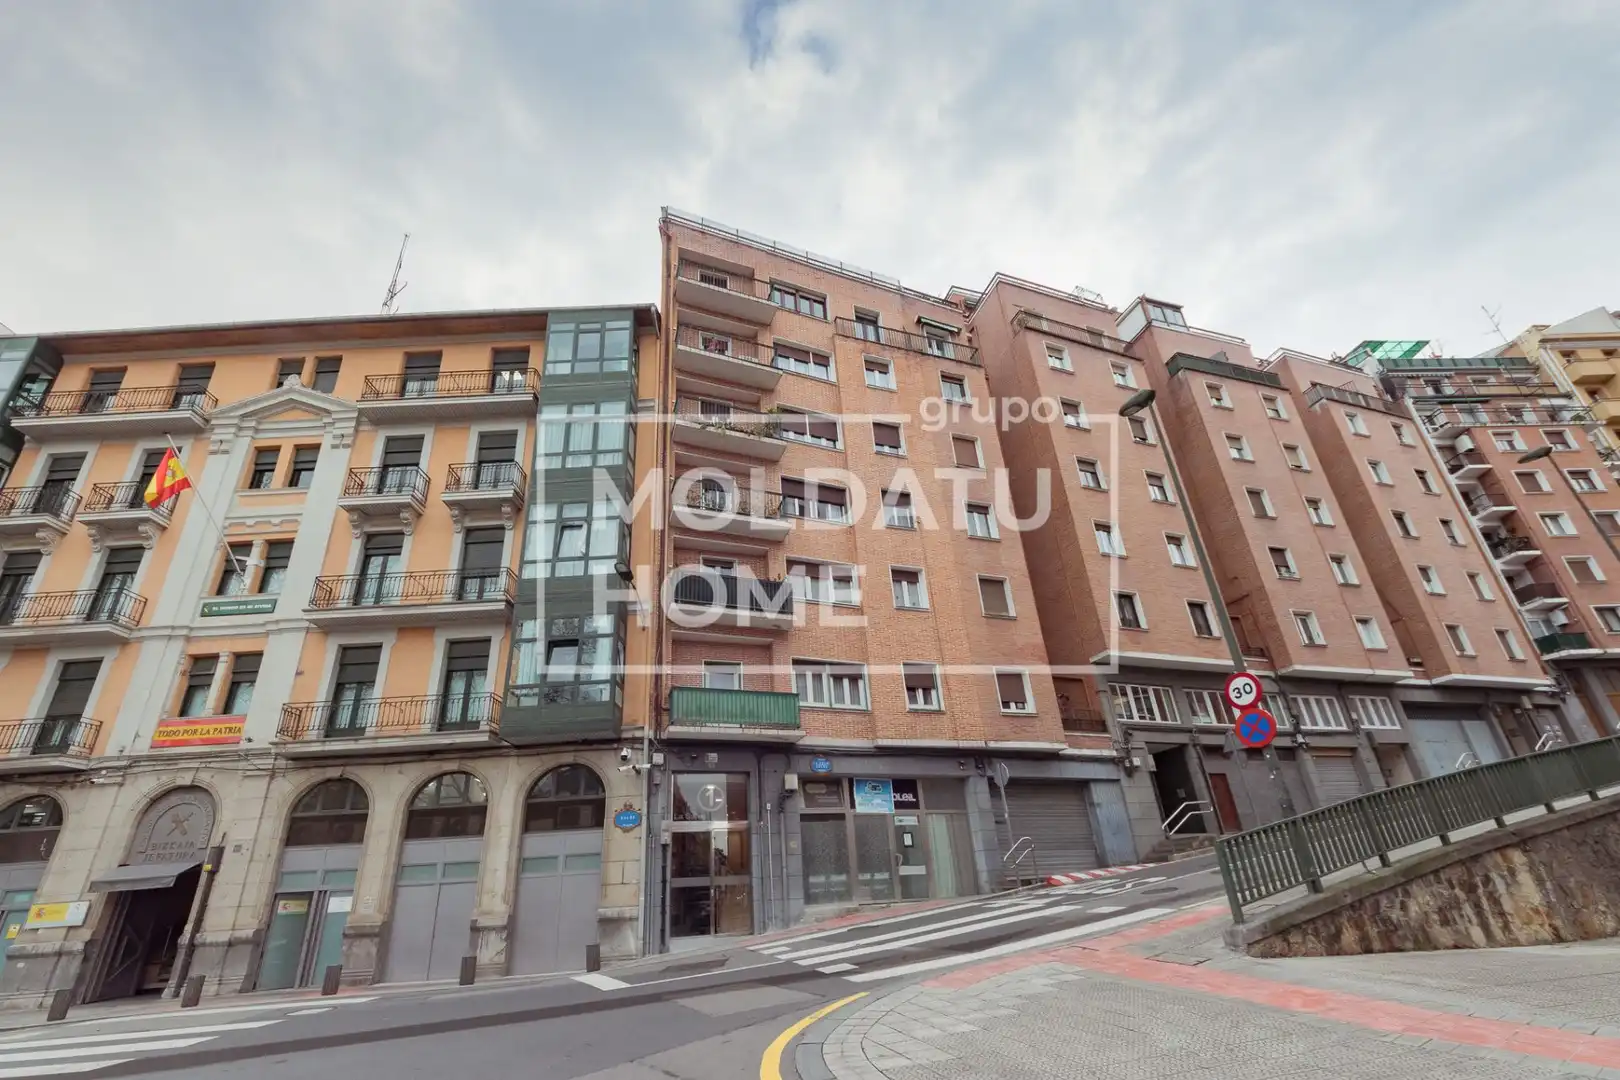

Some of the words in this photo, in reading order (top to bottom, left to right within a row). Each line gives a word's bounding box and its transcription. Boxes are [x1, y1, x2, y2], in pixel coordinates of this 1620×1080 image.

[1232, 683, 1253, 699] 30
[158, 729, 180, 738] TODO
[181, 728, 198, 737] POR
[198, 727, 210, 736] LA
[213, 726, 242, 735] PATRIA
[151, 840, 195, 851] BIZKAIA
